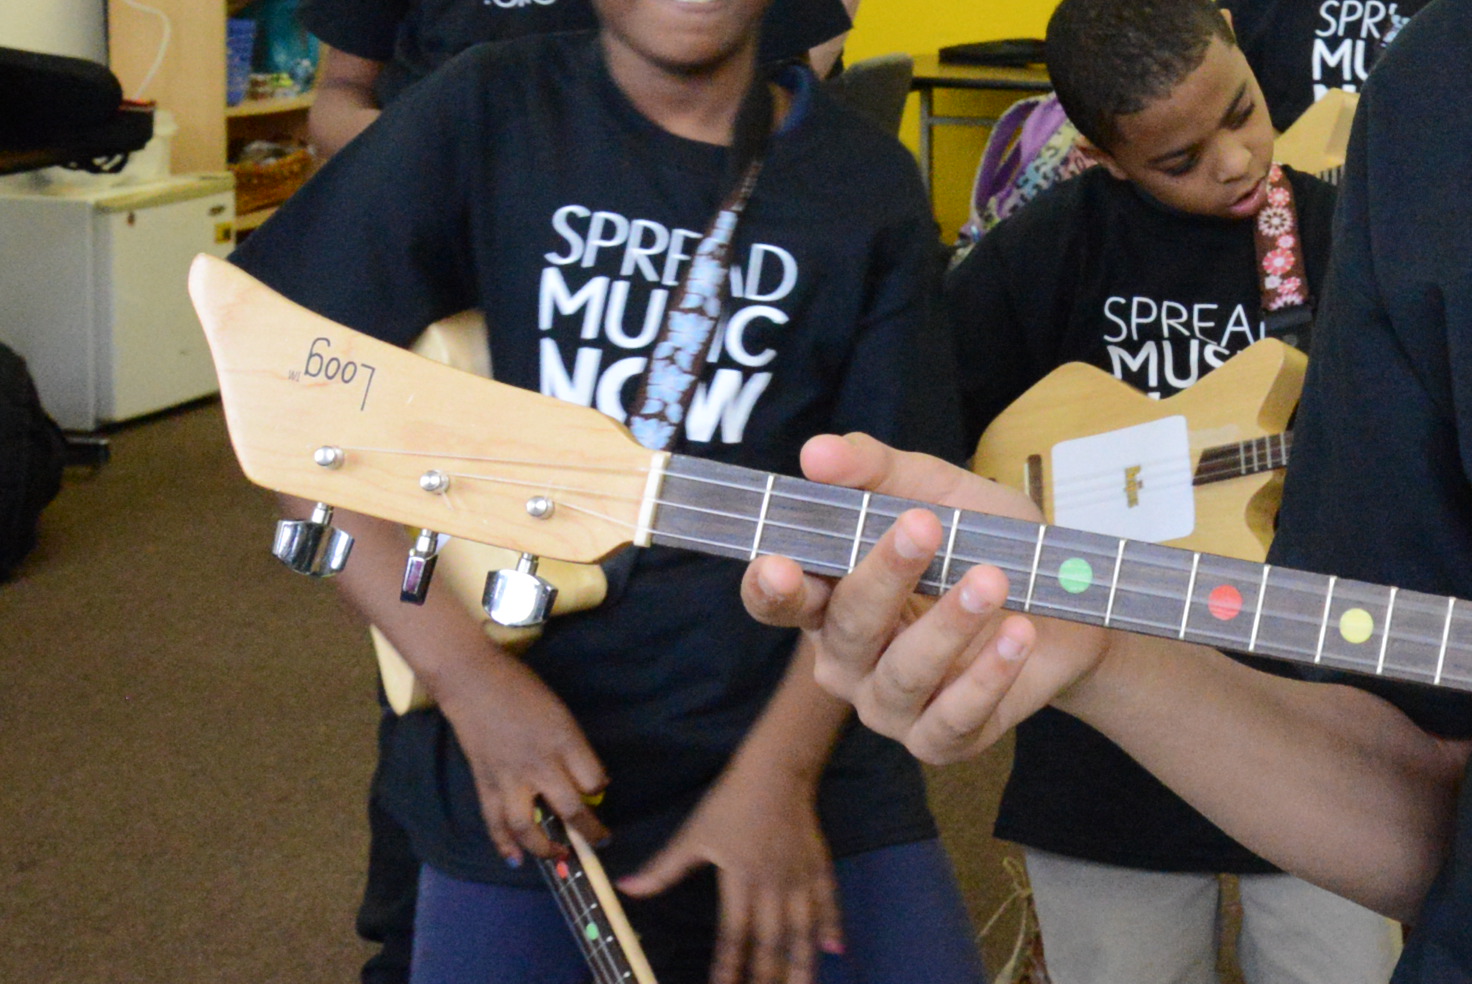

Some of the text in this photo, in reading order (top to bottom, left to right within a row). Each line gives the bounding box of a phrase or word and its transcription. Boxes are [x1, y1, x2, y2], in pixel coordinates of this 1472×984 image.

[1315, 0, 1398, 39] SPR
[538, 266, 790, 368] MUIC
[1103, 296, 1266, 348] SPREA
[304, 337, 376, 411] Loog
